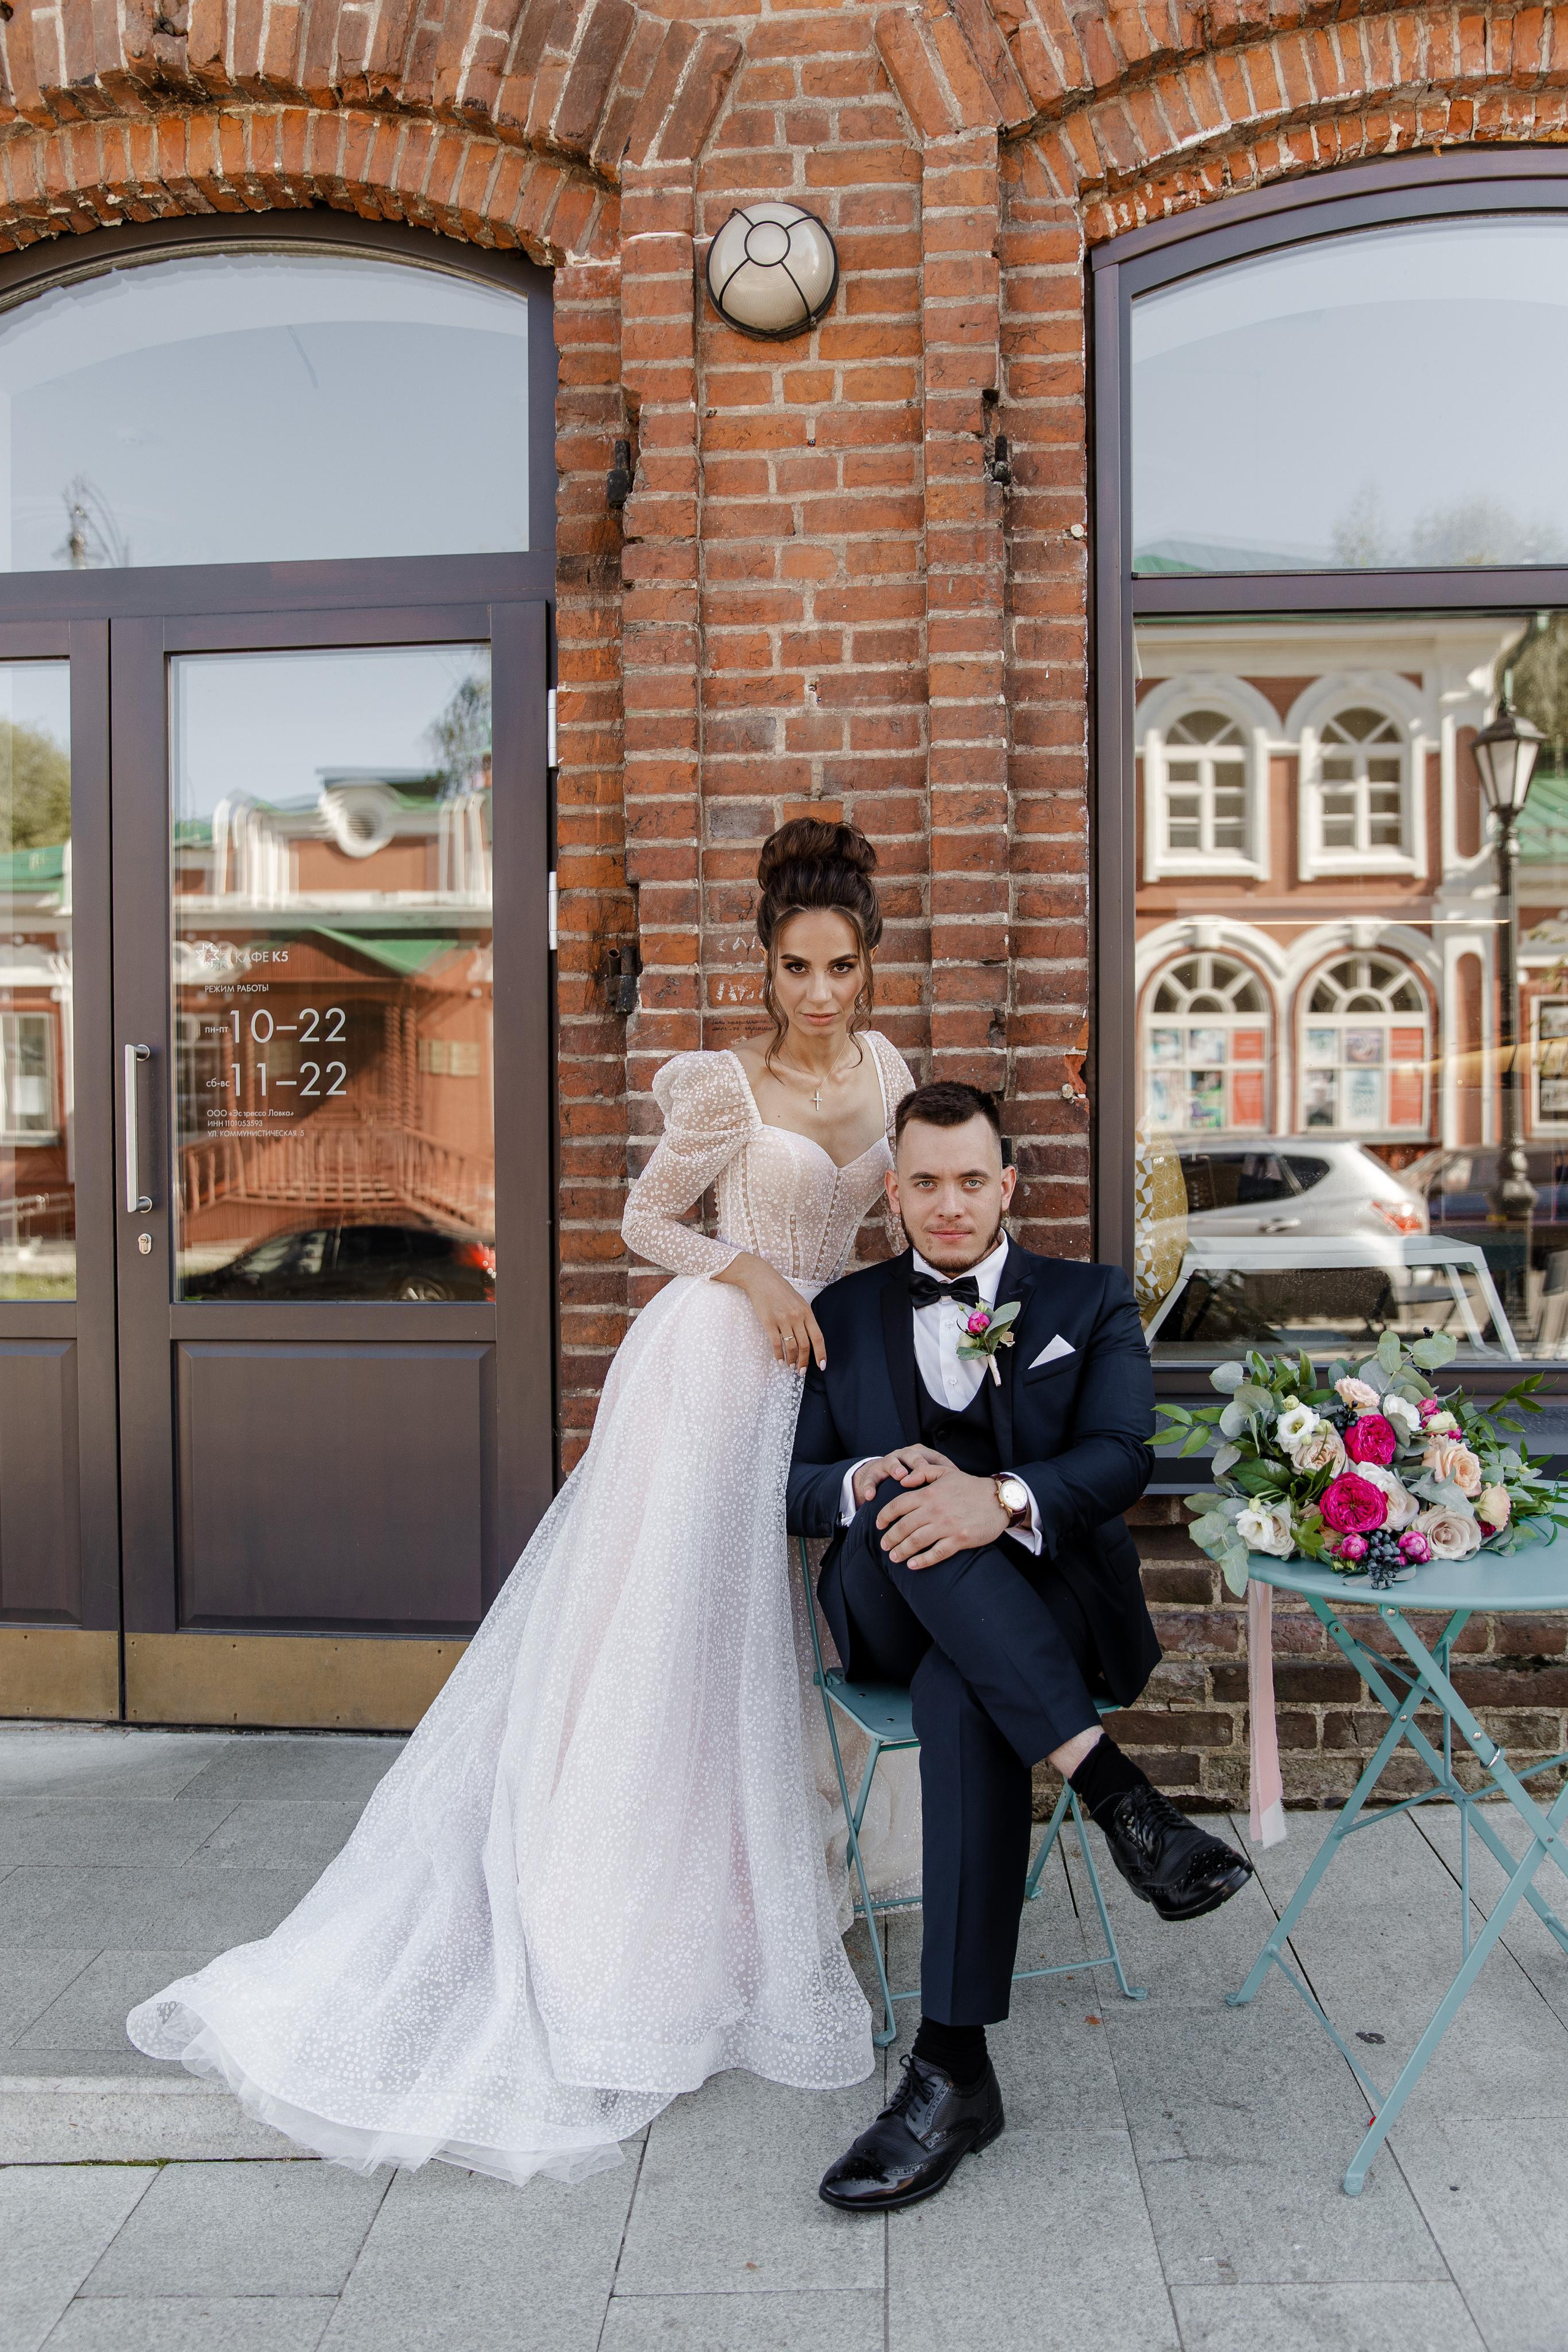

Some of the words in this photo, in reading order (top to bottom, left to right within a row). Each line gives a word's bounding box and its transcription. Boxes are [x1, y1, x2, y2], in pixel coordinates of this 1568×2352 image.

[235, 951, 269, 963] КАФЕ
[272, 951, 288, 963] К5
[237, 984, 269, 992] РАБОТЫ
[206, 1078, 230, 1087] сб-вс
